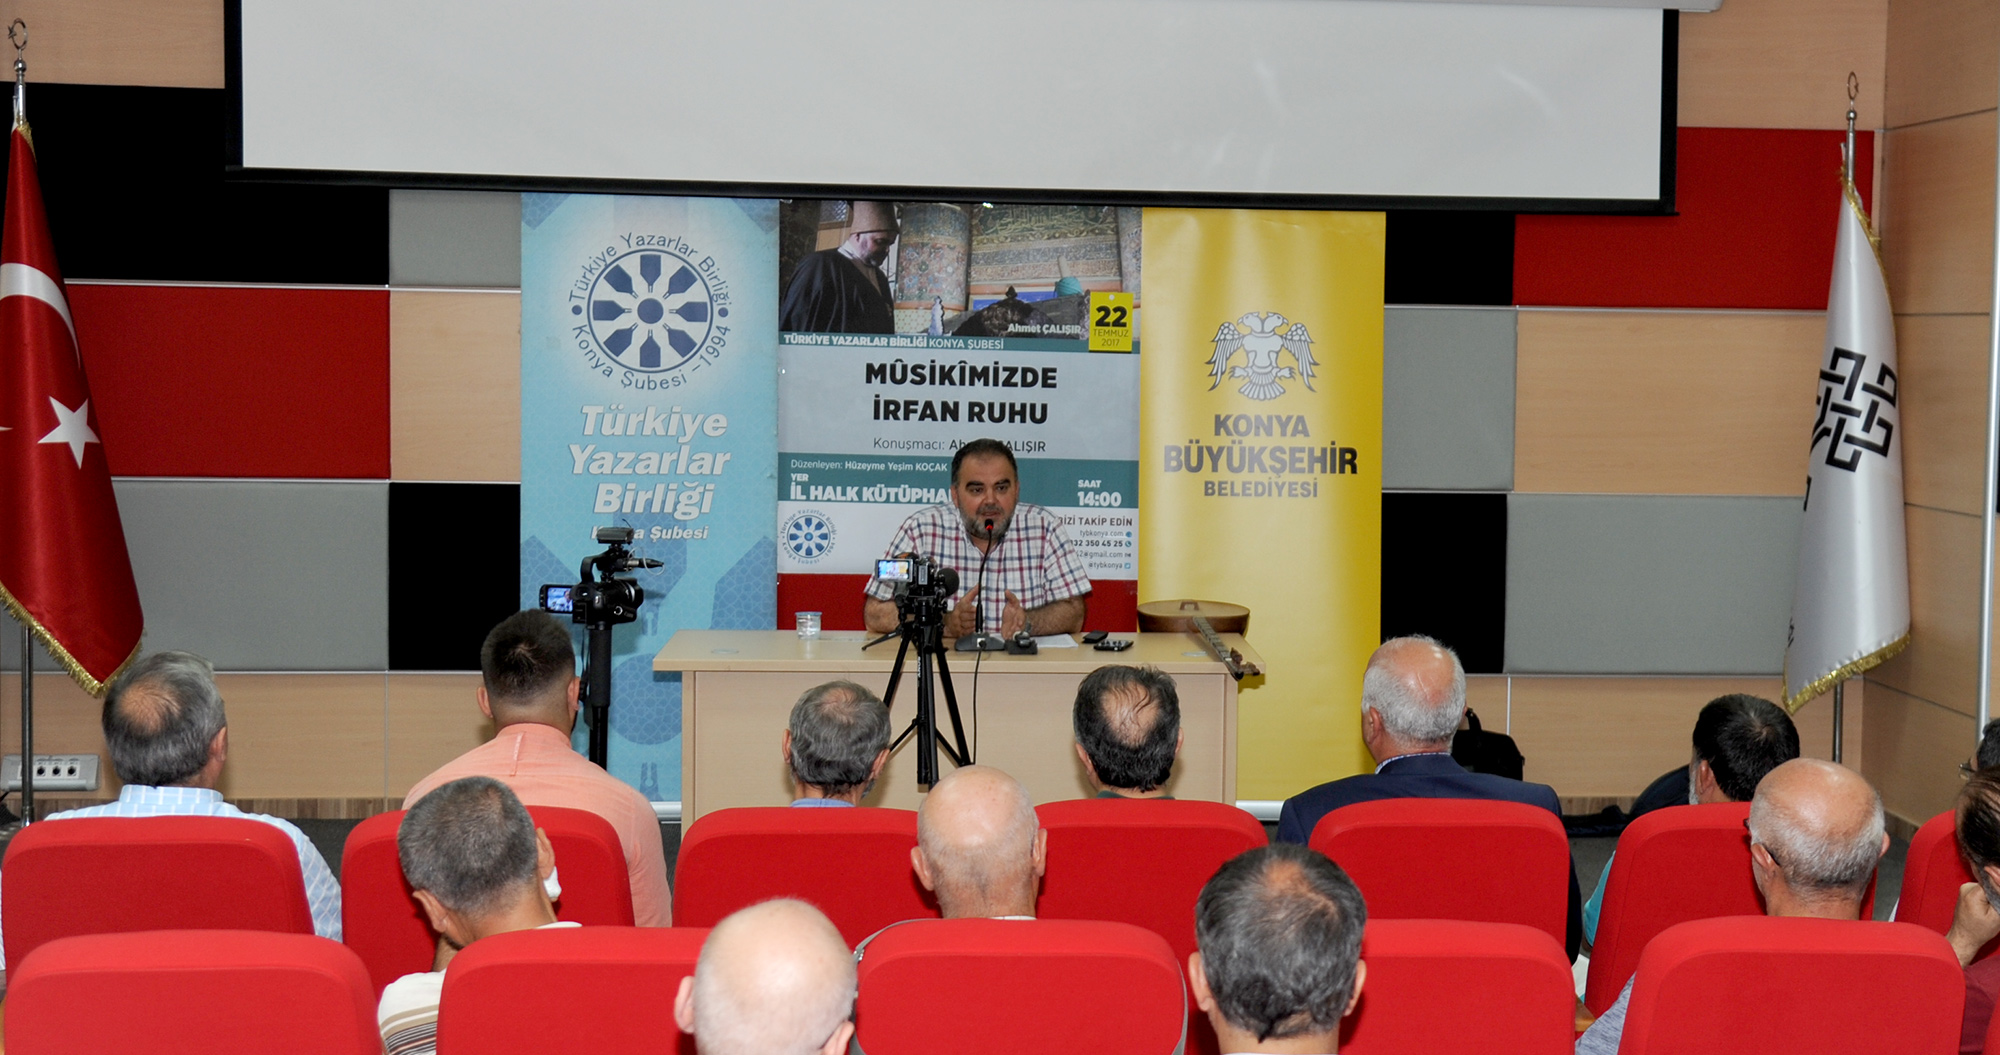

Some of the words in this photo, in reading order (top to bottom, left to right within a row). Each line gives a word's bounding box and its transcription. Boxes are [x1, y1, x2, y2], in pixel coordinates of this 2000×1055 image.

[568, 245, 617, 302] Türkiye
[620, 232, 698, 258] Yazarlar
[697, 256, 732, 306] Birliği
[1095, 305, 1127, 328] 22
[1007, 323, 1041, 333] Ahmet
[1043, 324, 1082, 335] ÇALIŞIR
[1093, 328, 1129, 338] TEMMUZ
[784, 332, 830, 345] TÜRKİYE
[832, 335, 888, 347] YAZARLAR
[889, 336, 927, 348] BİRLİĞİ
[929, 339, 965, 349] KONYA
[967, 338, 1004, 350] ŞUBESİ
[1101, 338, 1120, 347] 2017
[572, 324, 614, 378] Konya
[621, 369, 687, 390] Şubesi
[865, 358, 1057, 388] MÛSİKÎMİZDE
[873, 394, 960, 422] İRFAN
[968, 401, 1048, 424] RUHU
[581, 403, 728, 444] Türkiye
[1214, 413, 1310, 438] KONYA
[873, 437, 945, 451] Konuşmacı:
[1004, 440, 1046, 453] ALIŞIR
[568, 443, 732, 476] Yazarlar
[790, 459, 843, 470] Düzenleyen:
[888, 461, 913, 472] Yeşim
[915, 462, 948, 473] KOÇAK
[1163, 439, 1358, 478] BÜYÜKŞEHİR
[790, 473, 809, 482] YER
[1077, 479, 1102, 488] SAAT
[790, 481, 807, 501] İL
[809, 485, 859, 502] HALK
[862, 483, 951, 503] KÜTÜPHA
[1204, 477, 1318, 498] BELEDİYESİ
[593, 481, 716, 521] Birliği
[1077, 491, 1122, 507] 14:00
[1078, 514, 1108, 526] TAKİP
[1110, 515, 1133, 527] EDİN
[650, 525, 710, 542] Şubesi
[1080, 529, 1124, 538] tybkonya.com
[1085, 539, 1100, 547] 350
[1113, 540, 1123, 548] 25
[1088, 561, 1123, 570] @tybkonya
